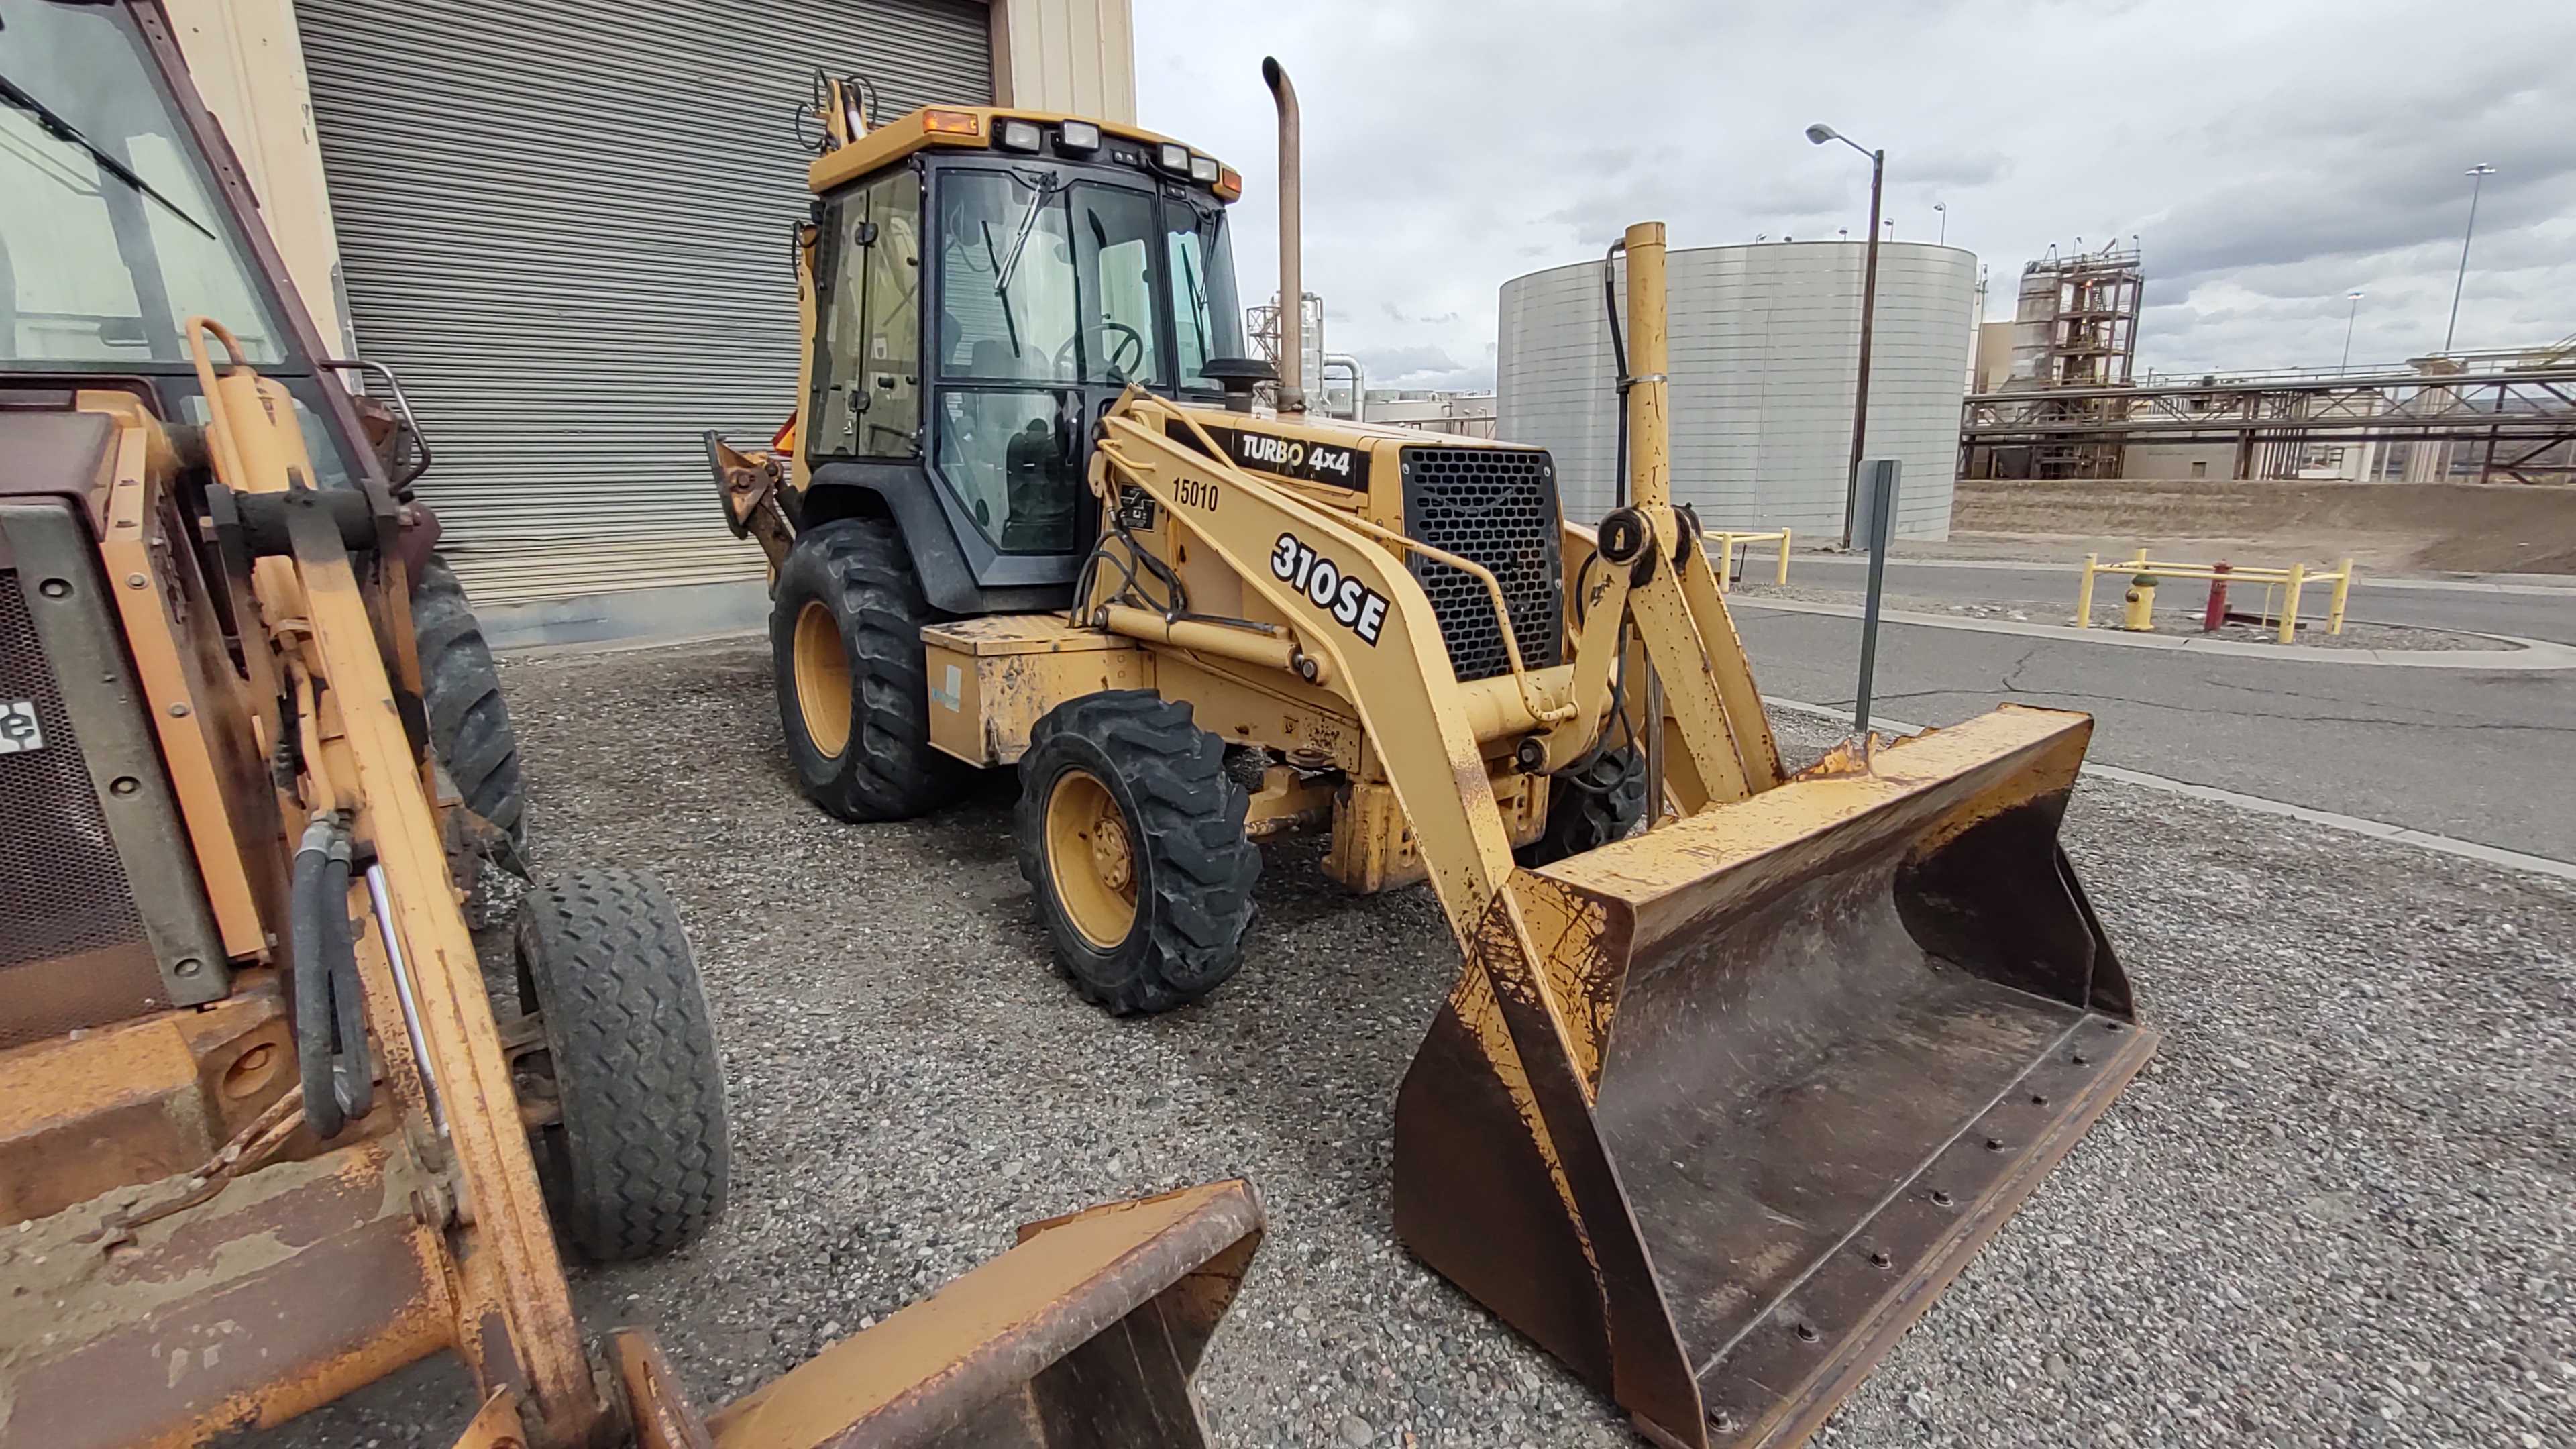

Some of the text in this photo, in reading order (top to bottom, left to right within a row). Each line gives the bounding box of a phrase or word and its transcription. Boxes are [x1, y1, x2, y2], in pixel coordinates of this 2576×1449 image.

[1243, 435, 1350, 476] TURBO 4x4
[1173, 477, 1218, 512] 15010
[1271, 533, 1391, 647] 310SE
